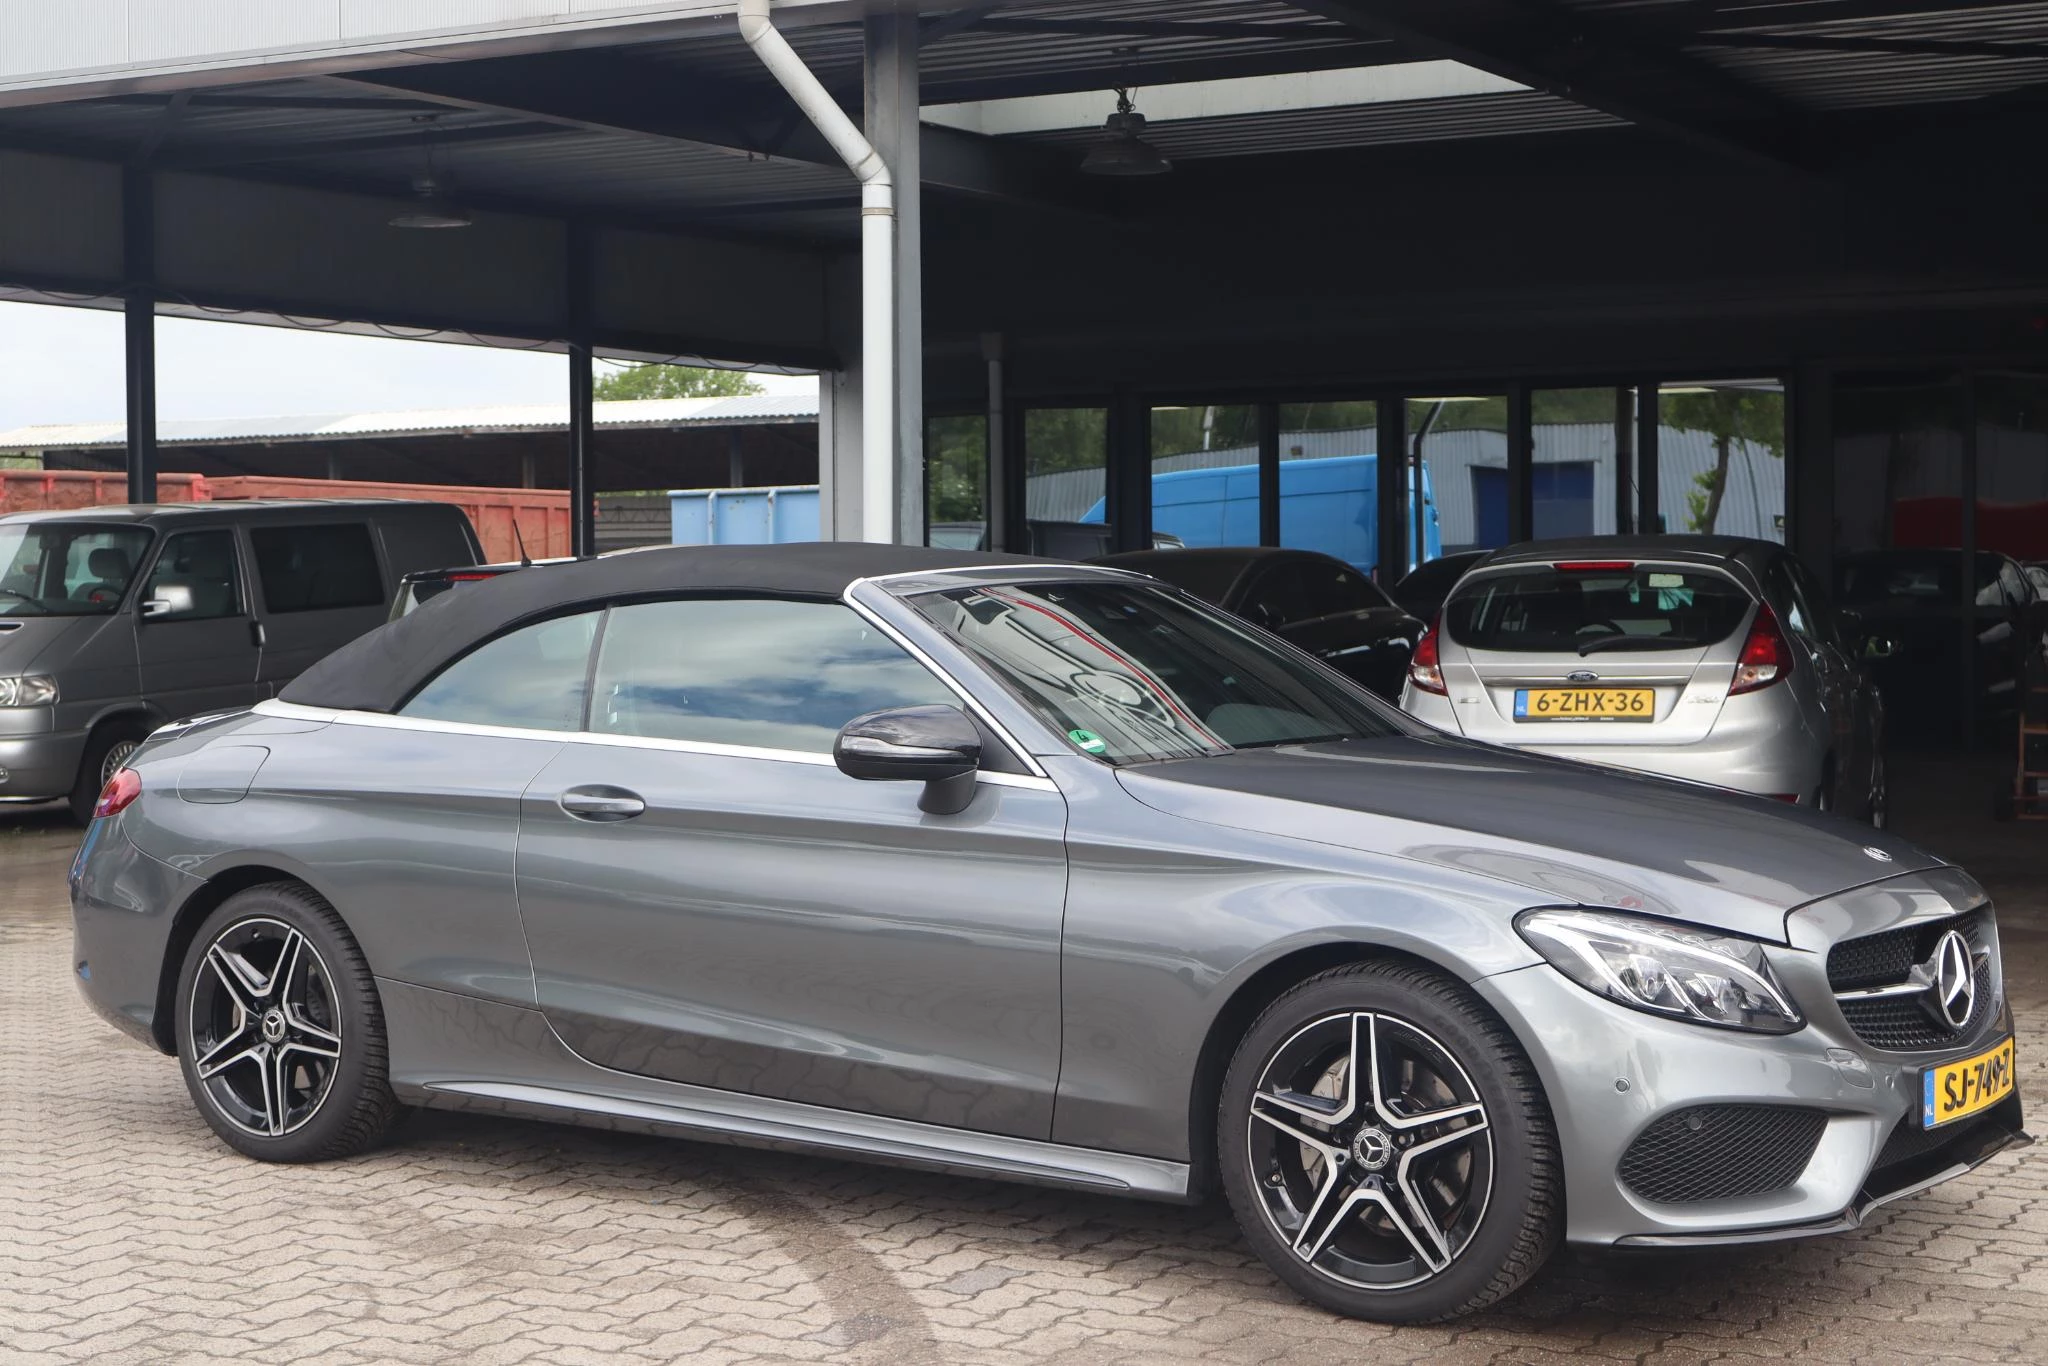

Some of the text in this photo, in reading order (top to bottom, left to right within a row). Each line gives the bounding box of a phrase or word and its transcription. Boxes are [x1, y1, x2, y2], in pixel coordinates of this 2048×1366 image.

[1536, 692, 1645, 712] 6-ZHX-36
[1075, 730, 1090, 743] 4
[1943, 1047, 2011, 1112] SJ-749-Z
[1924, 1103, 1934, 1117] NL
